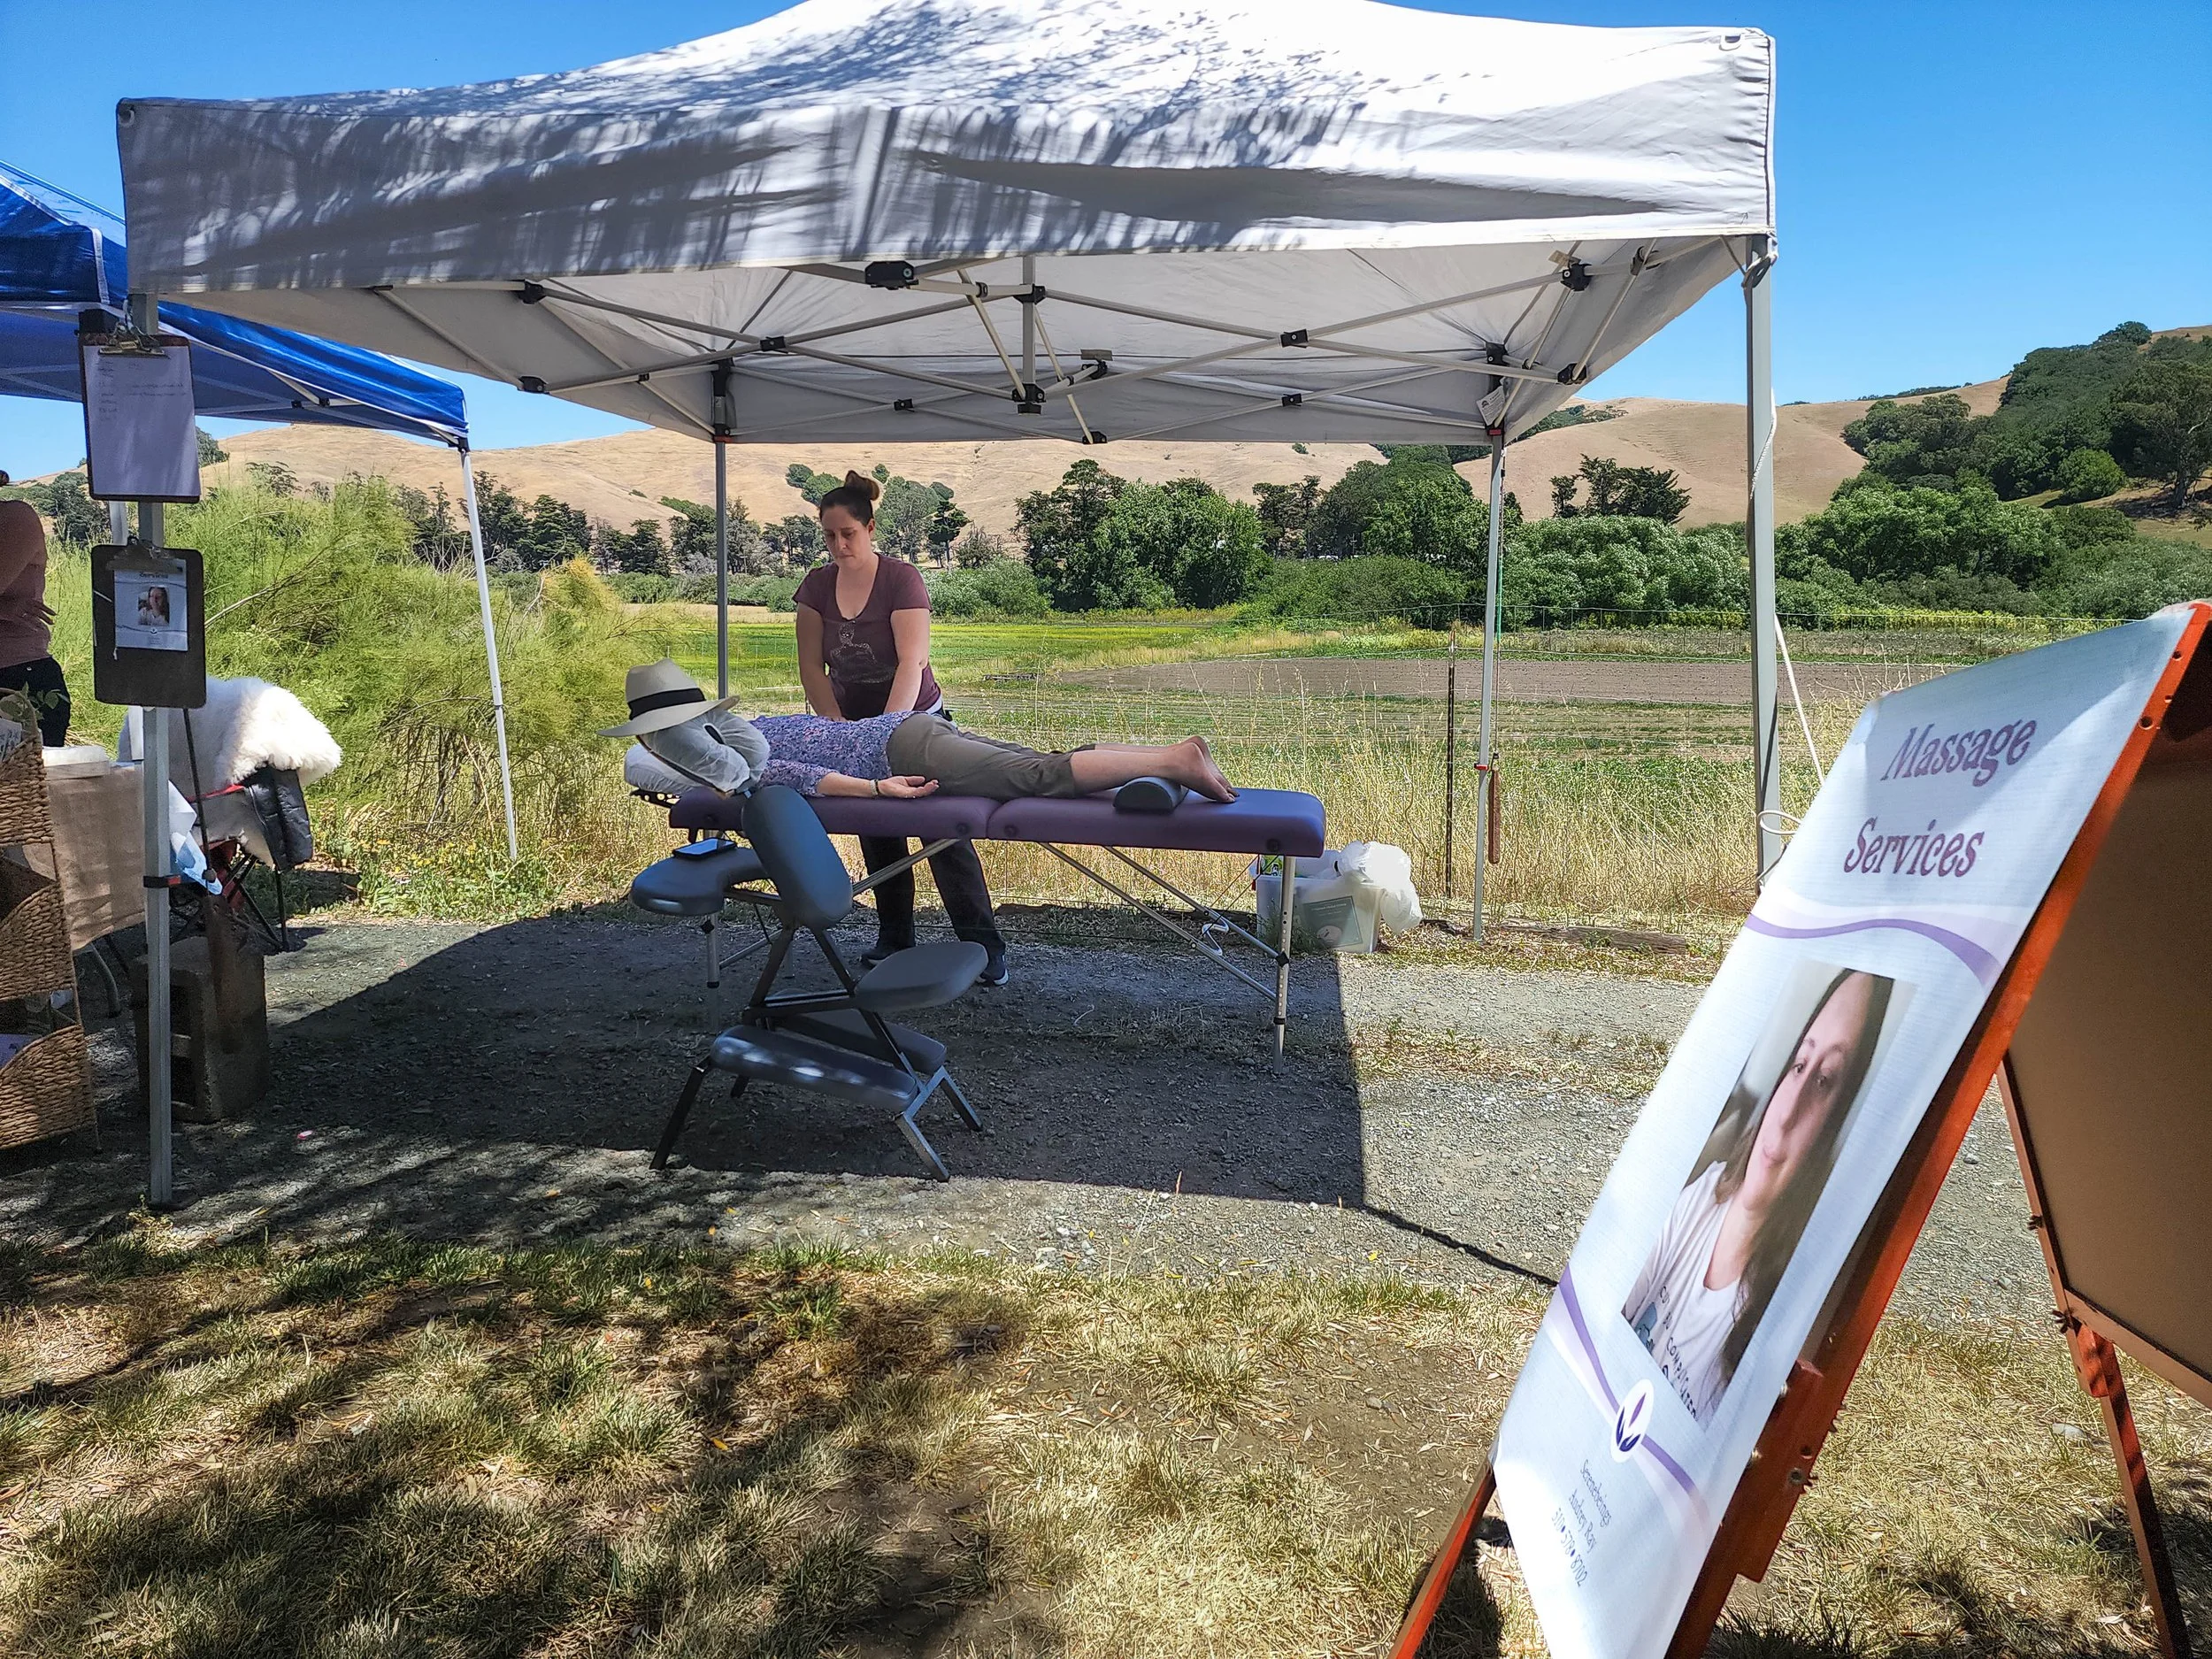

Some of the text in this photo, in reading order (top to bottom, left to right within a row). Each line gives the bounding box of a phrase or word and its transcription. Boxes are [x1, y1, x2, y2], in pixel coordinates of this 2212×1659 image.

[1880, 719, 2038, 787] Massage
[1843, 816, 1985, 878] Services
[1569, 1488, 1596, 1554] Audrey Ray
[1580, 1459, 1611, 1528] Serenebeings
